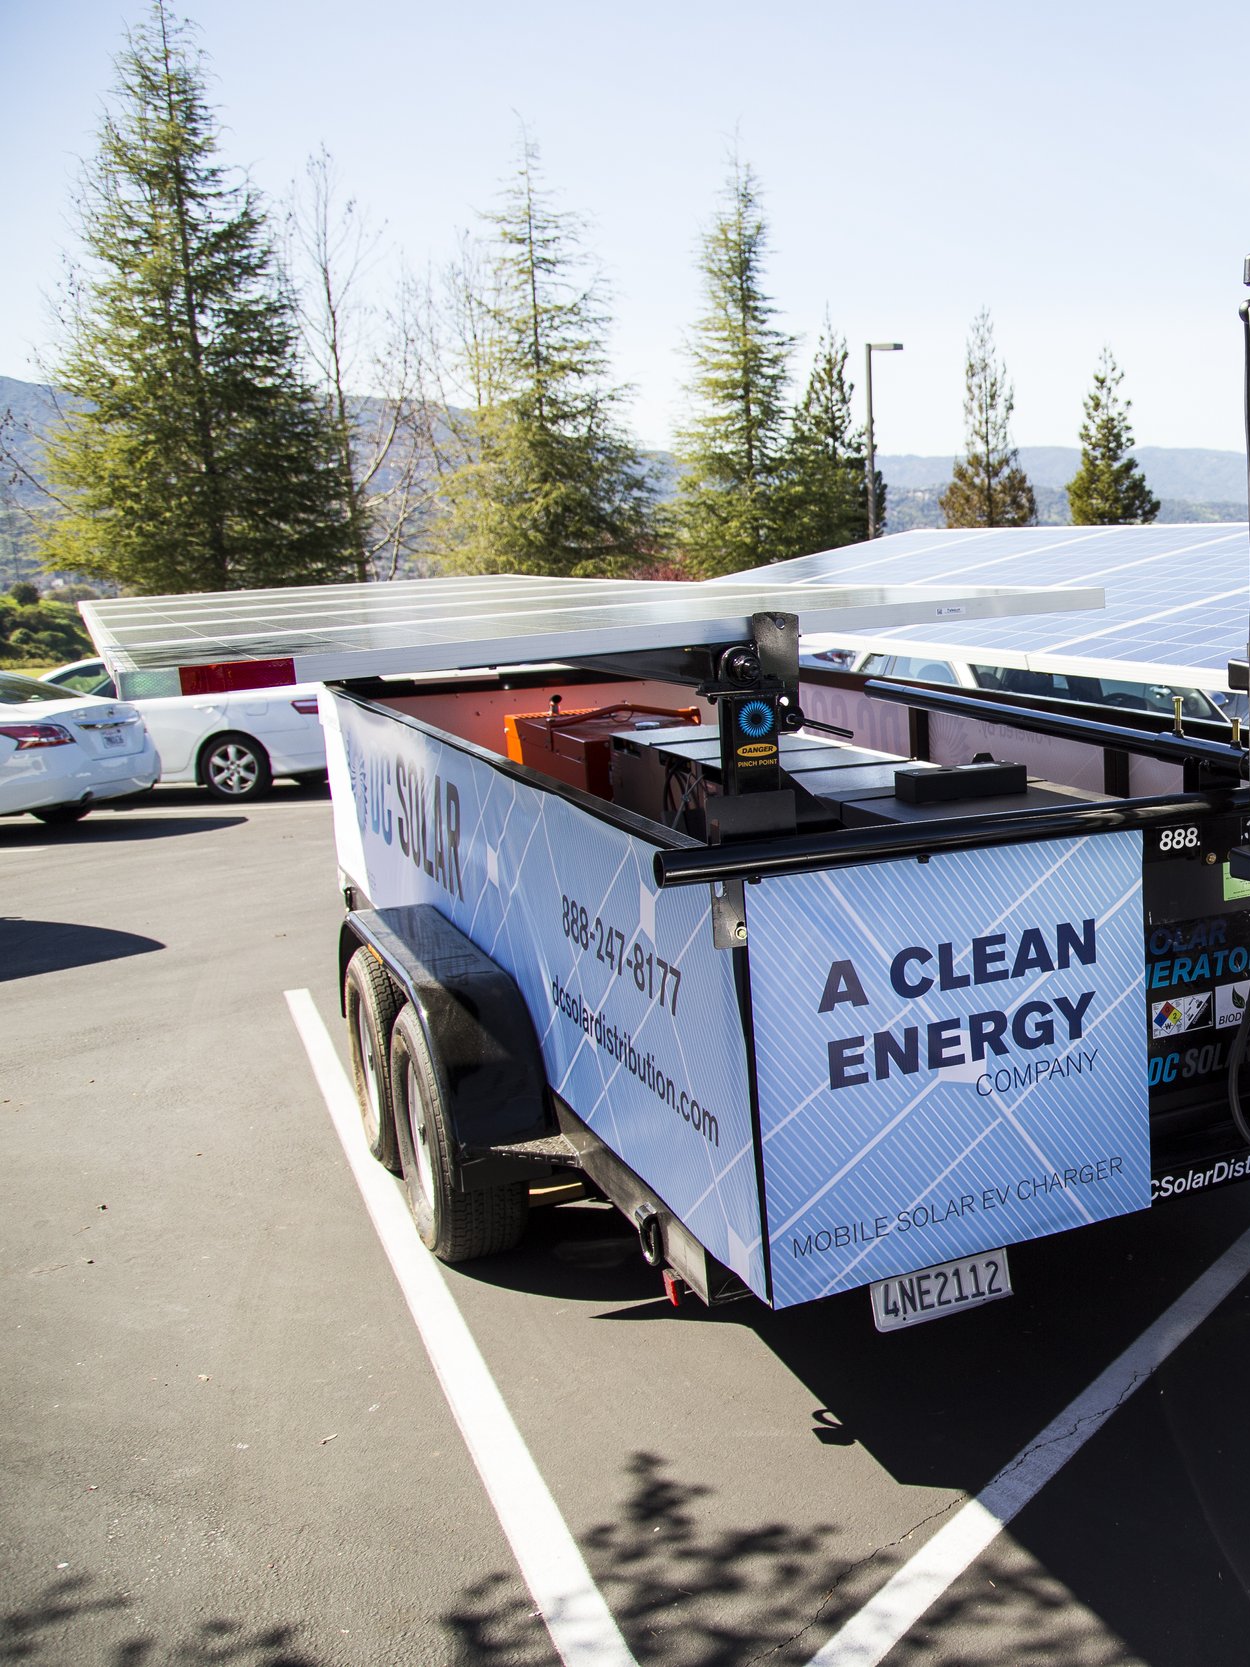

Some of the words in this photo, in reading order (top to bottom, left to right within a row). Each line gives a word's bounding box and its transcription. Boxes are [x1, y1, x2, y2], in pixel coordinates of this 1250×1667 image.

[737, 760, 758, 768] PINCH
[758, 758, 778, 766] POINT
[741, 745, 774, 755] DANGER
[395, 753, 465, 904] SOLAR
[561, 893, 683, 1018] 888-247-8177
[817, 958, 870, 1014] A
[889, 918, 1098, 1000] CLEAN
[1146, 917, 1228, 957] OLAR
[826, 990, 1098, 1091] ENERGY
[1172, 1012, 1178, 1020] 2
[551, 973, 720, 1147] dcsolardistribution.com
[975, 1049, 1099, 1098] COMPANY
[1148, 1051, 1180, 1088] DC
[791, 1215, 891, 1259] MOBILE
[896, 1194, 975, 1232] SOLAR
[982, 1184, 1013, 1211] EV
[1016, 1155, 1124, 1201] CHARGER
[882, 1259, 1003, 1317] 4NE2112
